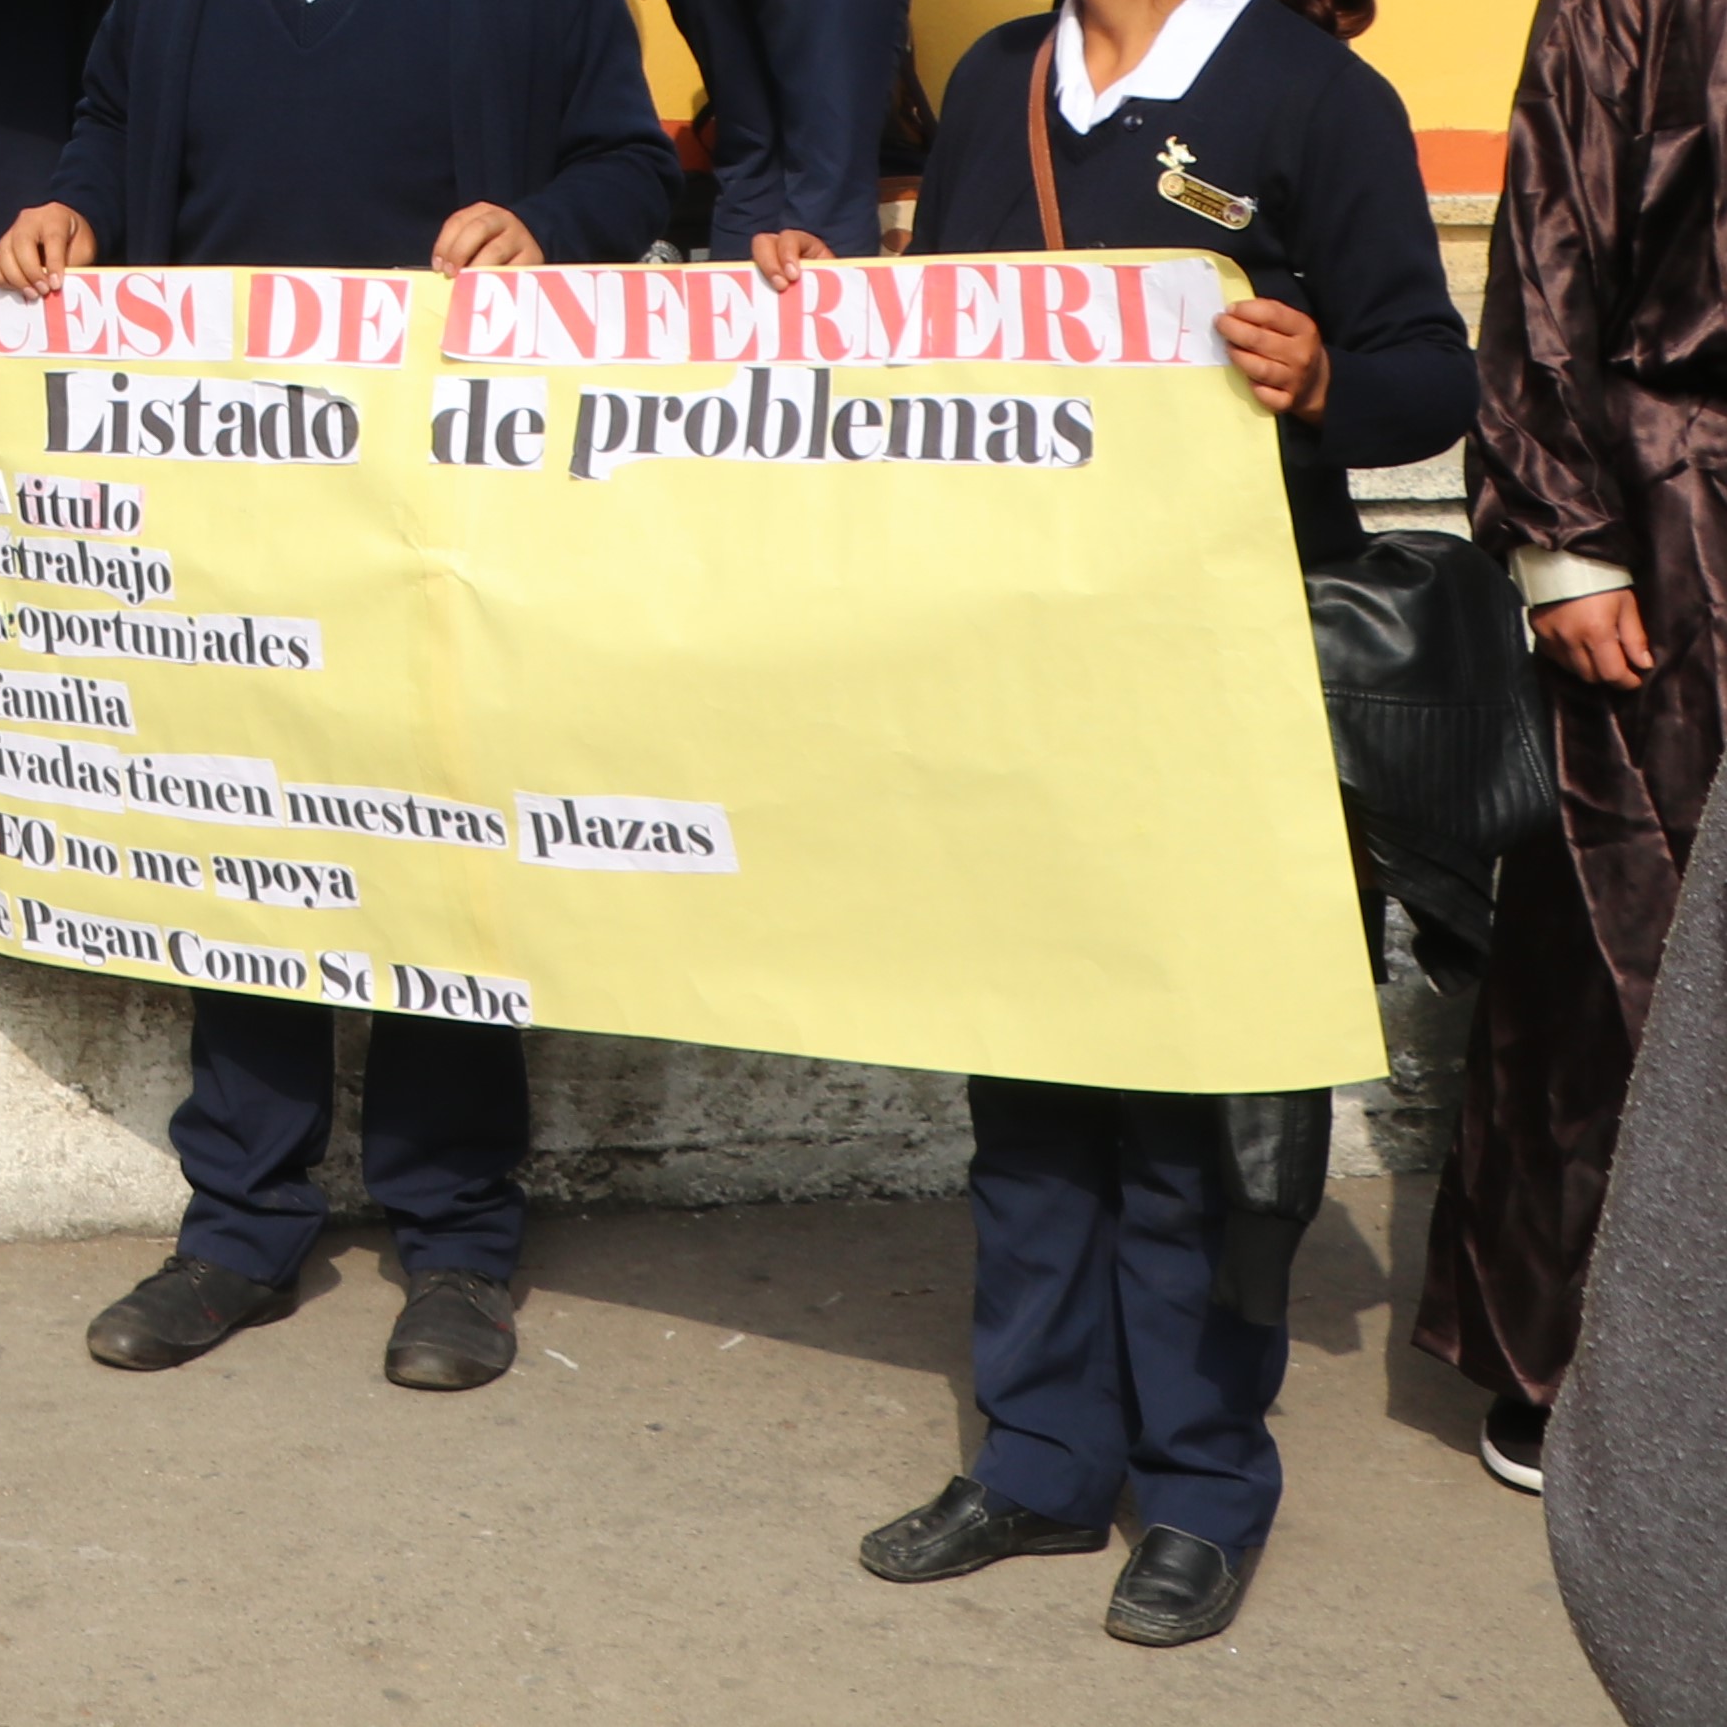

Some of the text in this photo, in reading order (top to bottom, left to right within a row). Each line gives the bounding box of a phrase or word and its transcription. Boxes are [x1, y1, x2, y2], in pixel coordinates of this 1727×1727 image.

[245, 273, 410, 365] DE
[44, 367, 1094, 480] Listado de problemas
[17, 479, 140, 532] titulo
[16, 537, 172, 605] trabajo
[126, 757, 276, 818] tienen
[285, 794, 507, 846] nuestras
[528, 798, 716, 858] plazas
[63, 836, 118, 875] no
[131, 849, 202, 888] me
[213, 854, 358, 909] apoya
[17, 897, 160, 966] Pagan
[168, 930, 308, 991] Como
[392, 963, 531, 1026] Debe
